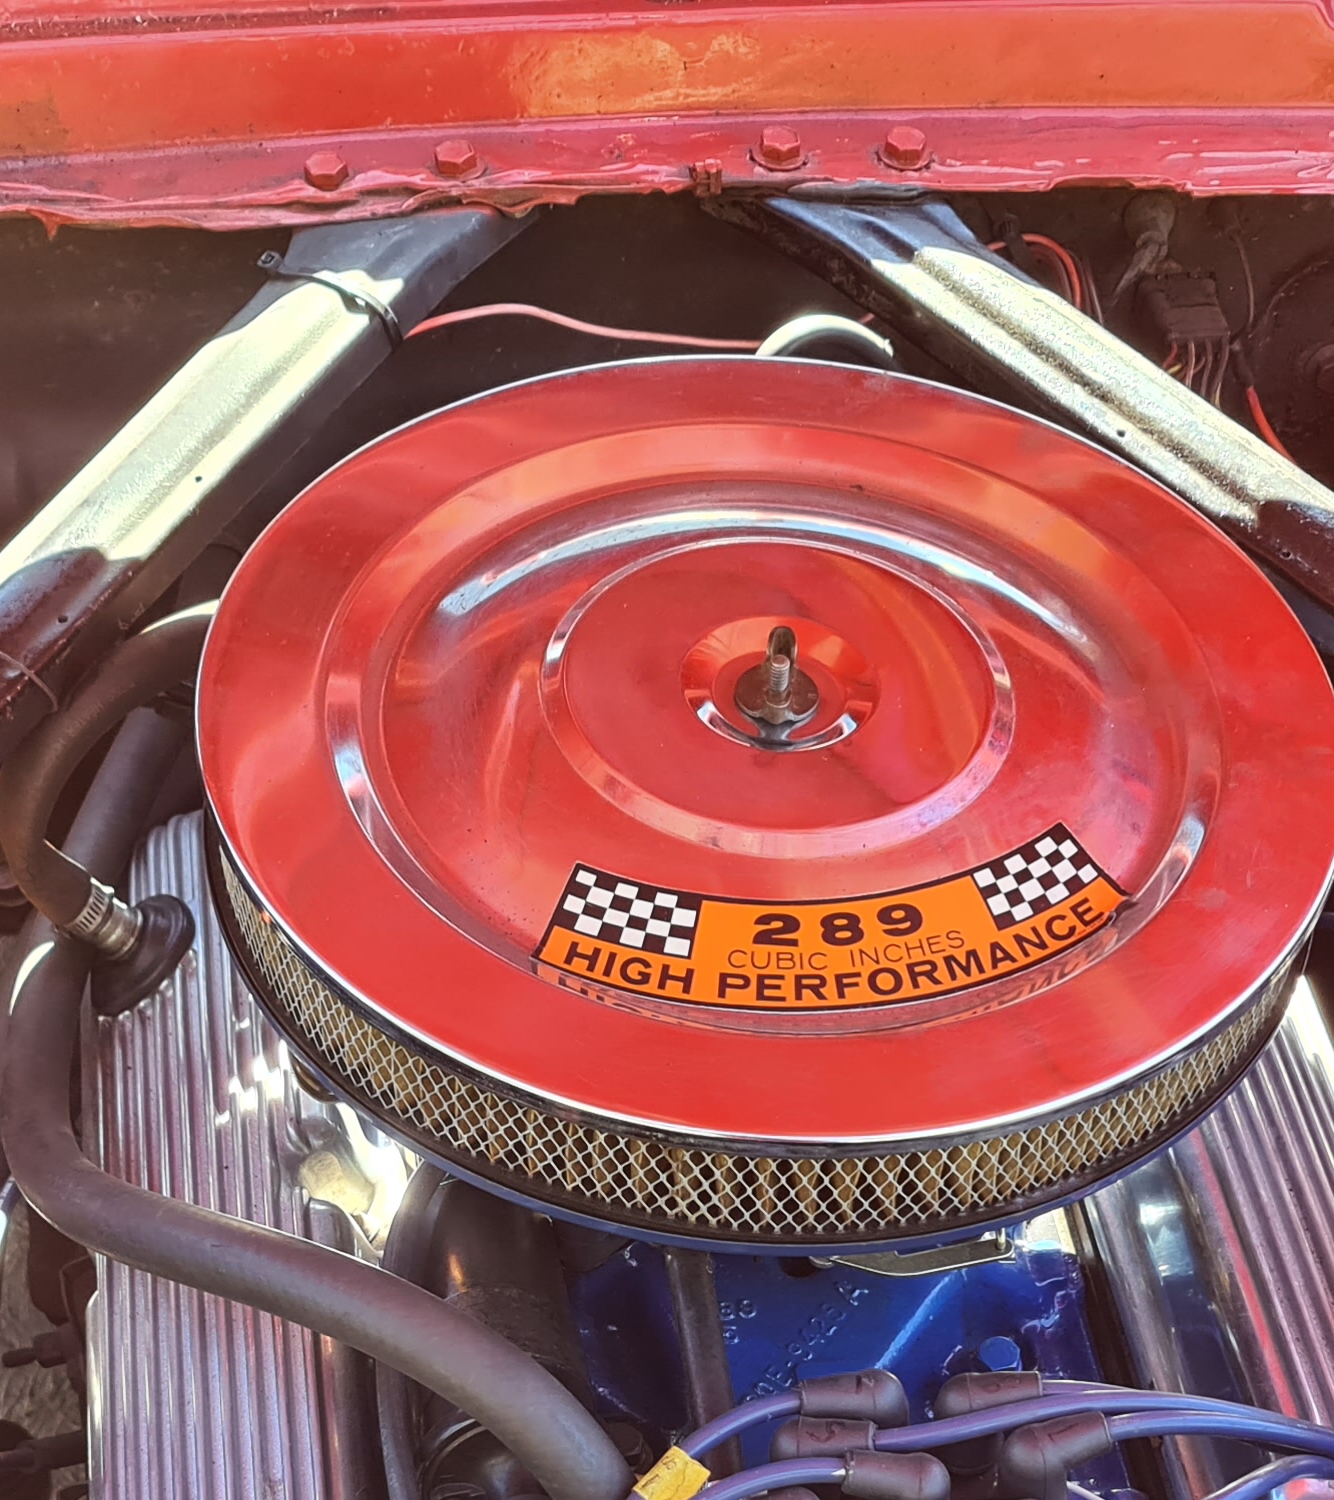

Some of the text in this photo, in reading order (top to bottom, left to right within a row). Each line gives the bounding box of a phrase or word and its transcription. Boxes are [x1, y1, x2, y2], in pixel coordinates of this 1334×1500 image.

[752, 901, 925, 947] 289
[563, 896, 1105, 1001] HIGH PERFORMANCE
[727, 930, 966, 971] CUBIC INCHES
